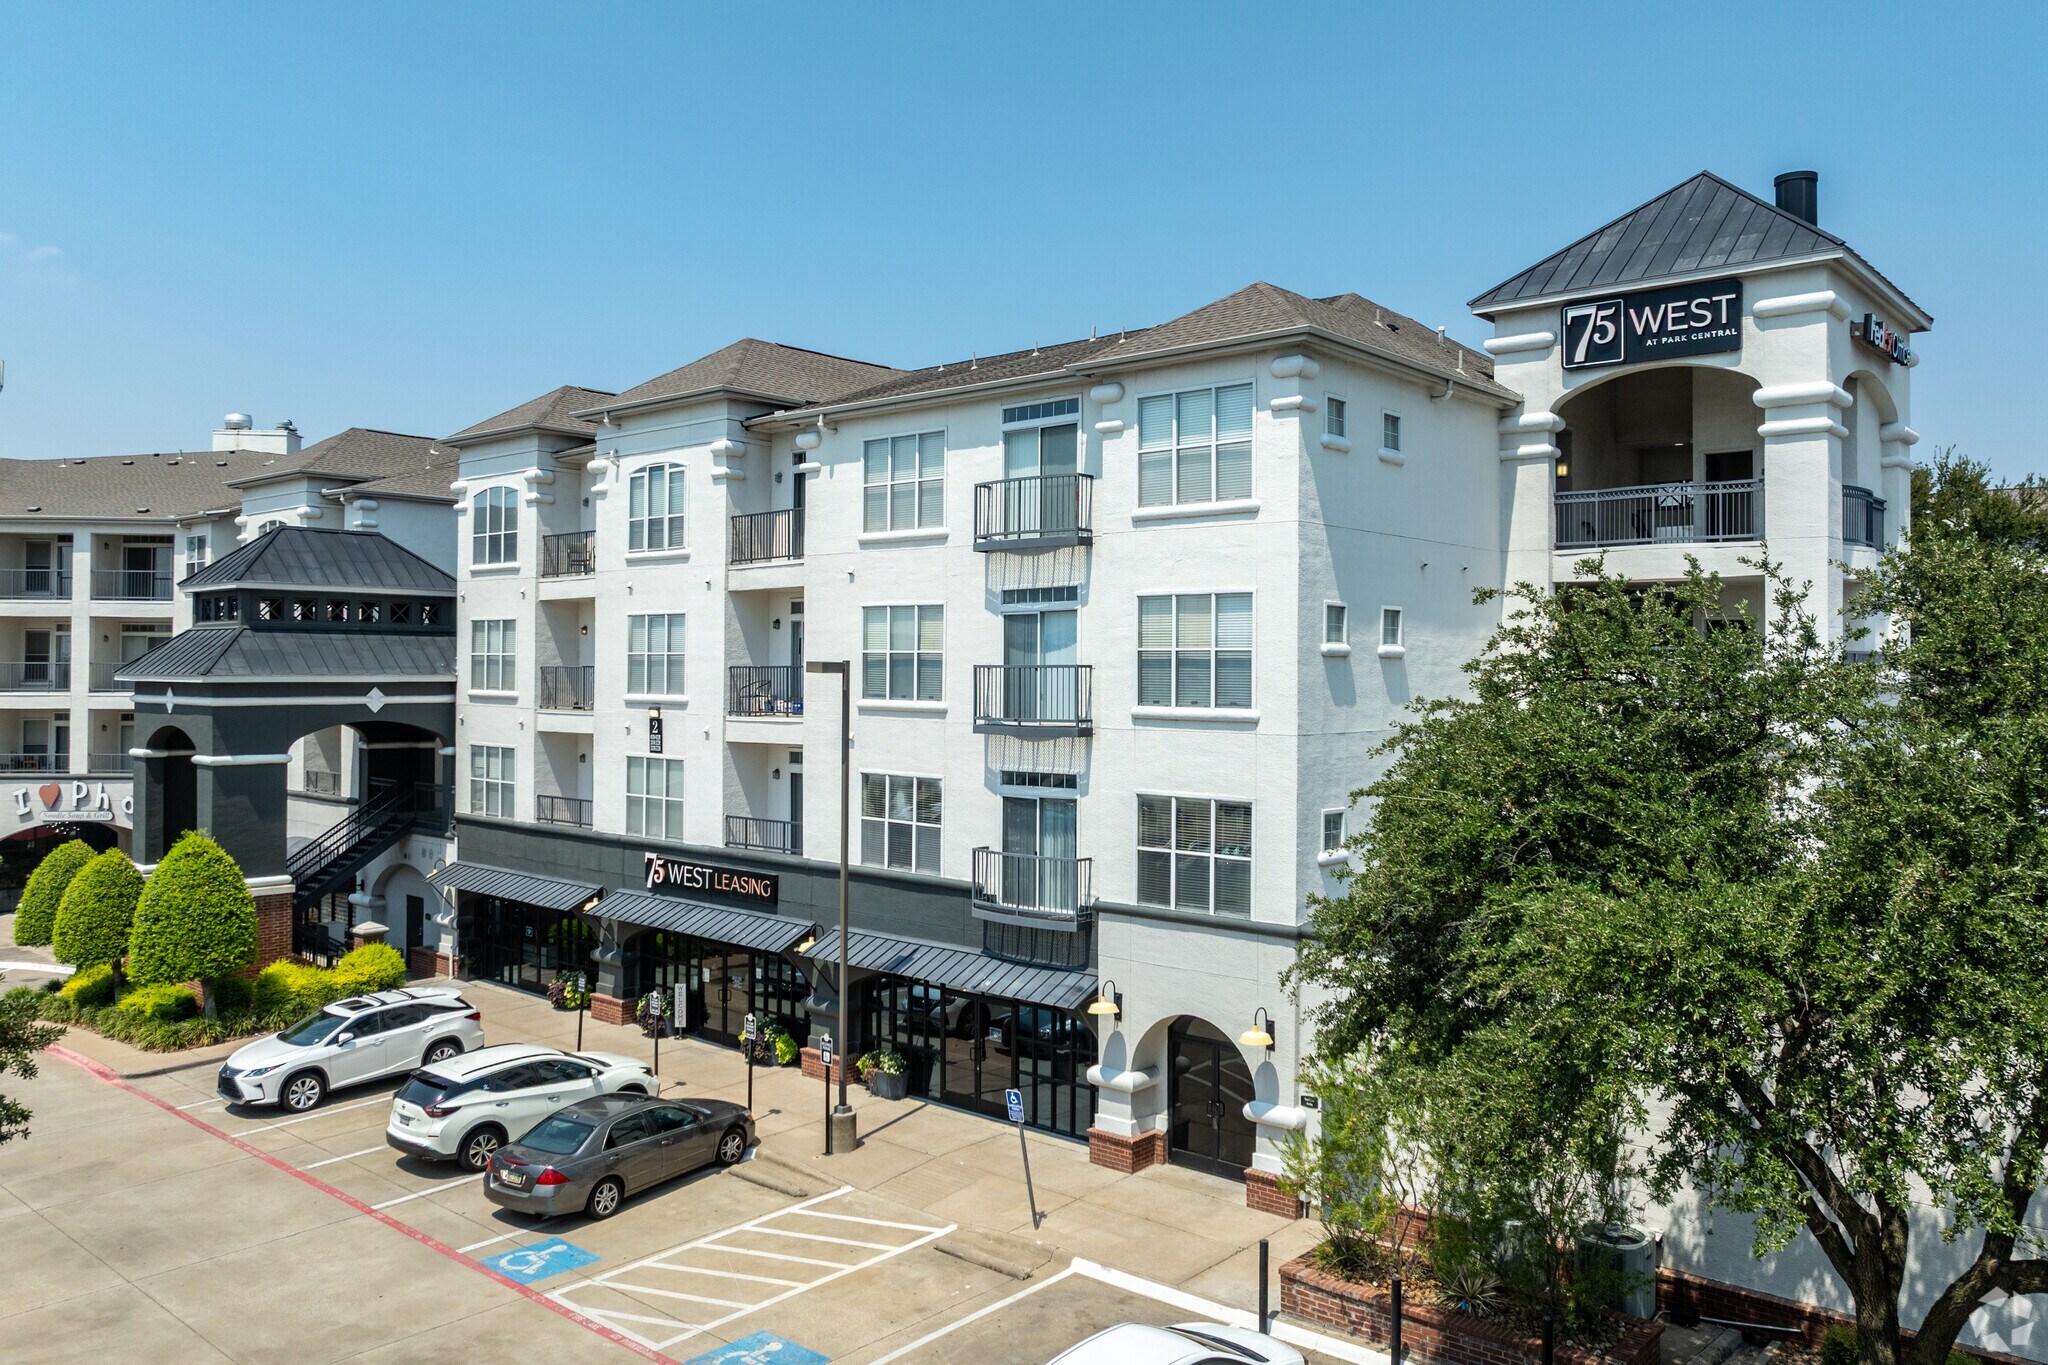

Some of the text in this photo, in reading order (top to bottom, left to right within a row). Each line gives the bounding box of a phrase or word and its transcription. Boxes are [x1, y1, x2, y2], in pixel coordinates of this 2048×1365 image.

[1566, 293, 1737, 363] 75 WEST
[1645, 328, 1738, 347] AT PARK CENTRAL
[652, 720, 659, 734] 2
[12, 780, 134, 816] I Pho
[66, 812, 85, 820] Soup
[644, 852, 772, 897] 75 WEST LEASING
